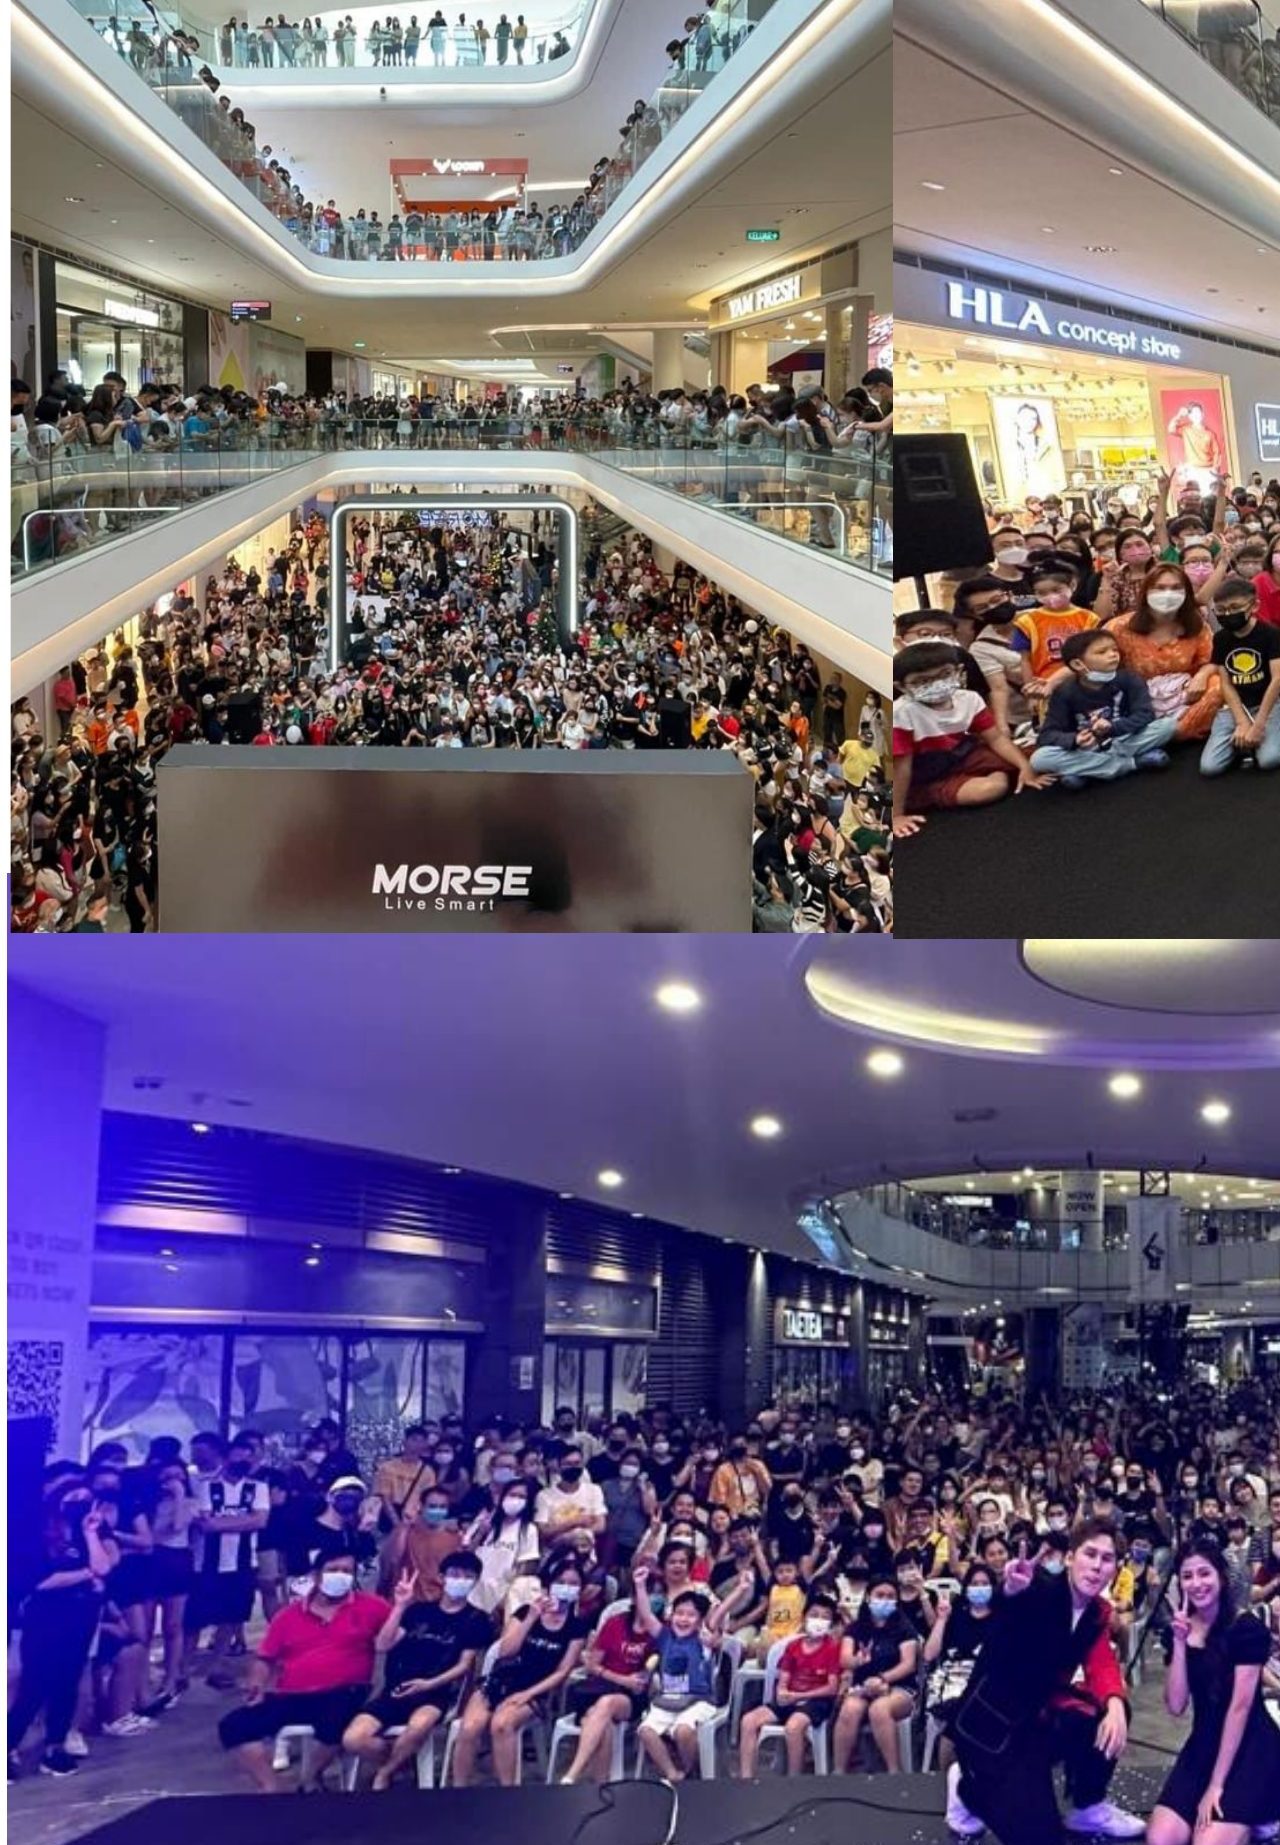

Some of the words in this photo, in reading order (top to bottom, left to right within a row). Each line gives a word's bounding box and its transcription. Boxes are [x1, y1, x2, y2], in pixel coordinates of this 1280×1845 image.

[756, 275, 801, 311] FRESH
[948, 281, 1052, 335] HLA
[1057, 319, 1136, 353] concept
[1141, 335, 1182, 360] store
[371, 863, 533, 897] MORSE
[384, 897, 427, 911] Live
[434, 897, 495, 911] Smart
